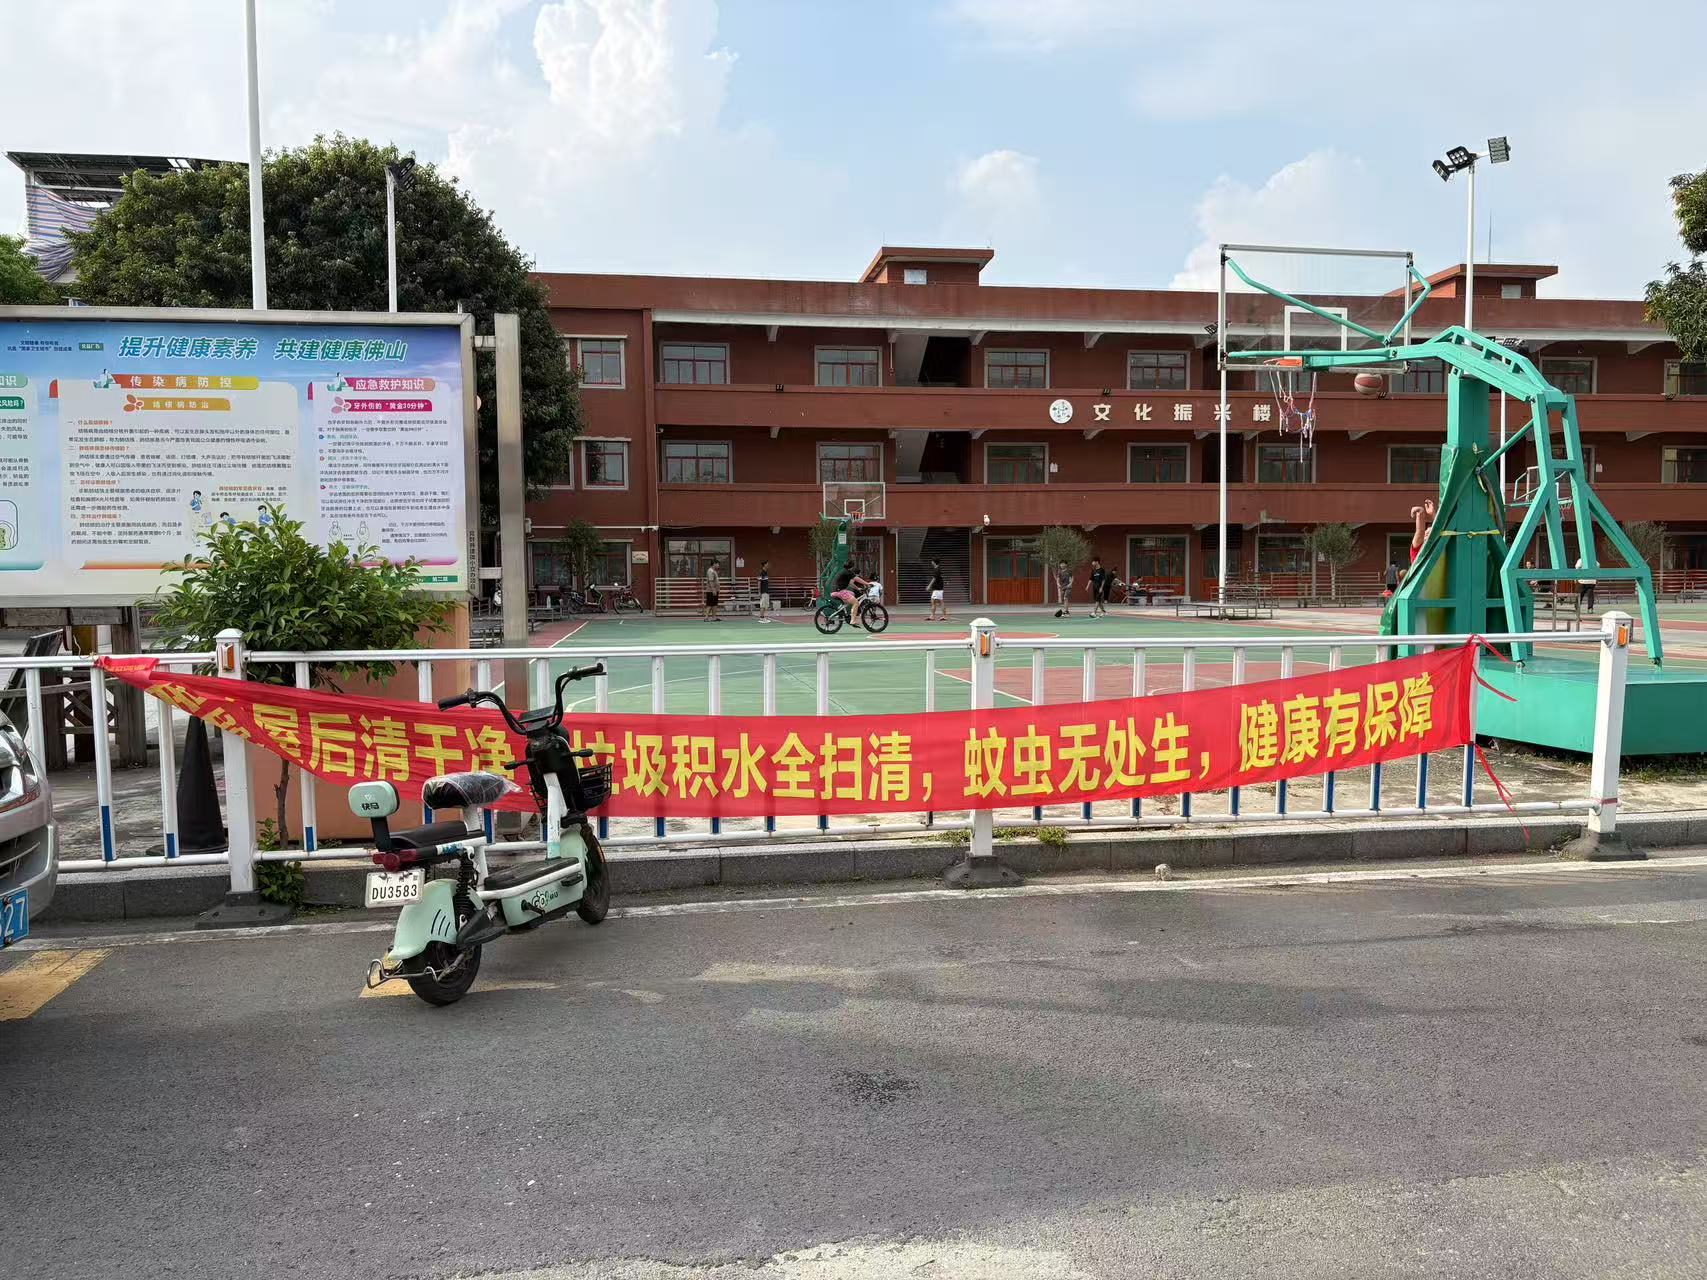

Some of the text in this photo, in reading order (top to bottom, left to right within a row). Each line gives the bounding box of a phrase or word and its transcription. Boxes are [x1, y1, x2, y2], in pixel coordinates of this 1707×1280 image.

[118, 336, 408, 362] 提升健康素养 共建健康佛山
[130, 376, 233, 389] 传染病防控
[355, 378, 425, 391] 应急救护知识
[1093, 403, 1272, 422] 文化振兴楼
[146, 683, 516, 781] 屋后清干净
[1238, 671, 1435, 773] 健康有保障
[361, 802, 380, 811] 快马
[372, 884, 418, 900] DU3583
[0, 896, 26, 938] 27
